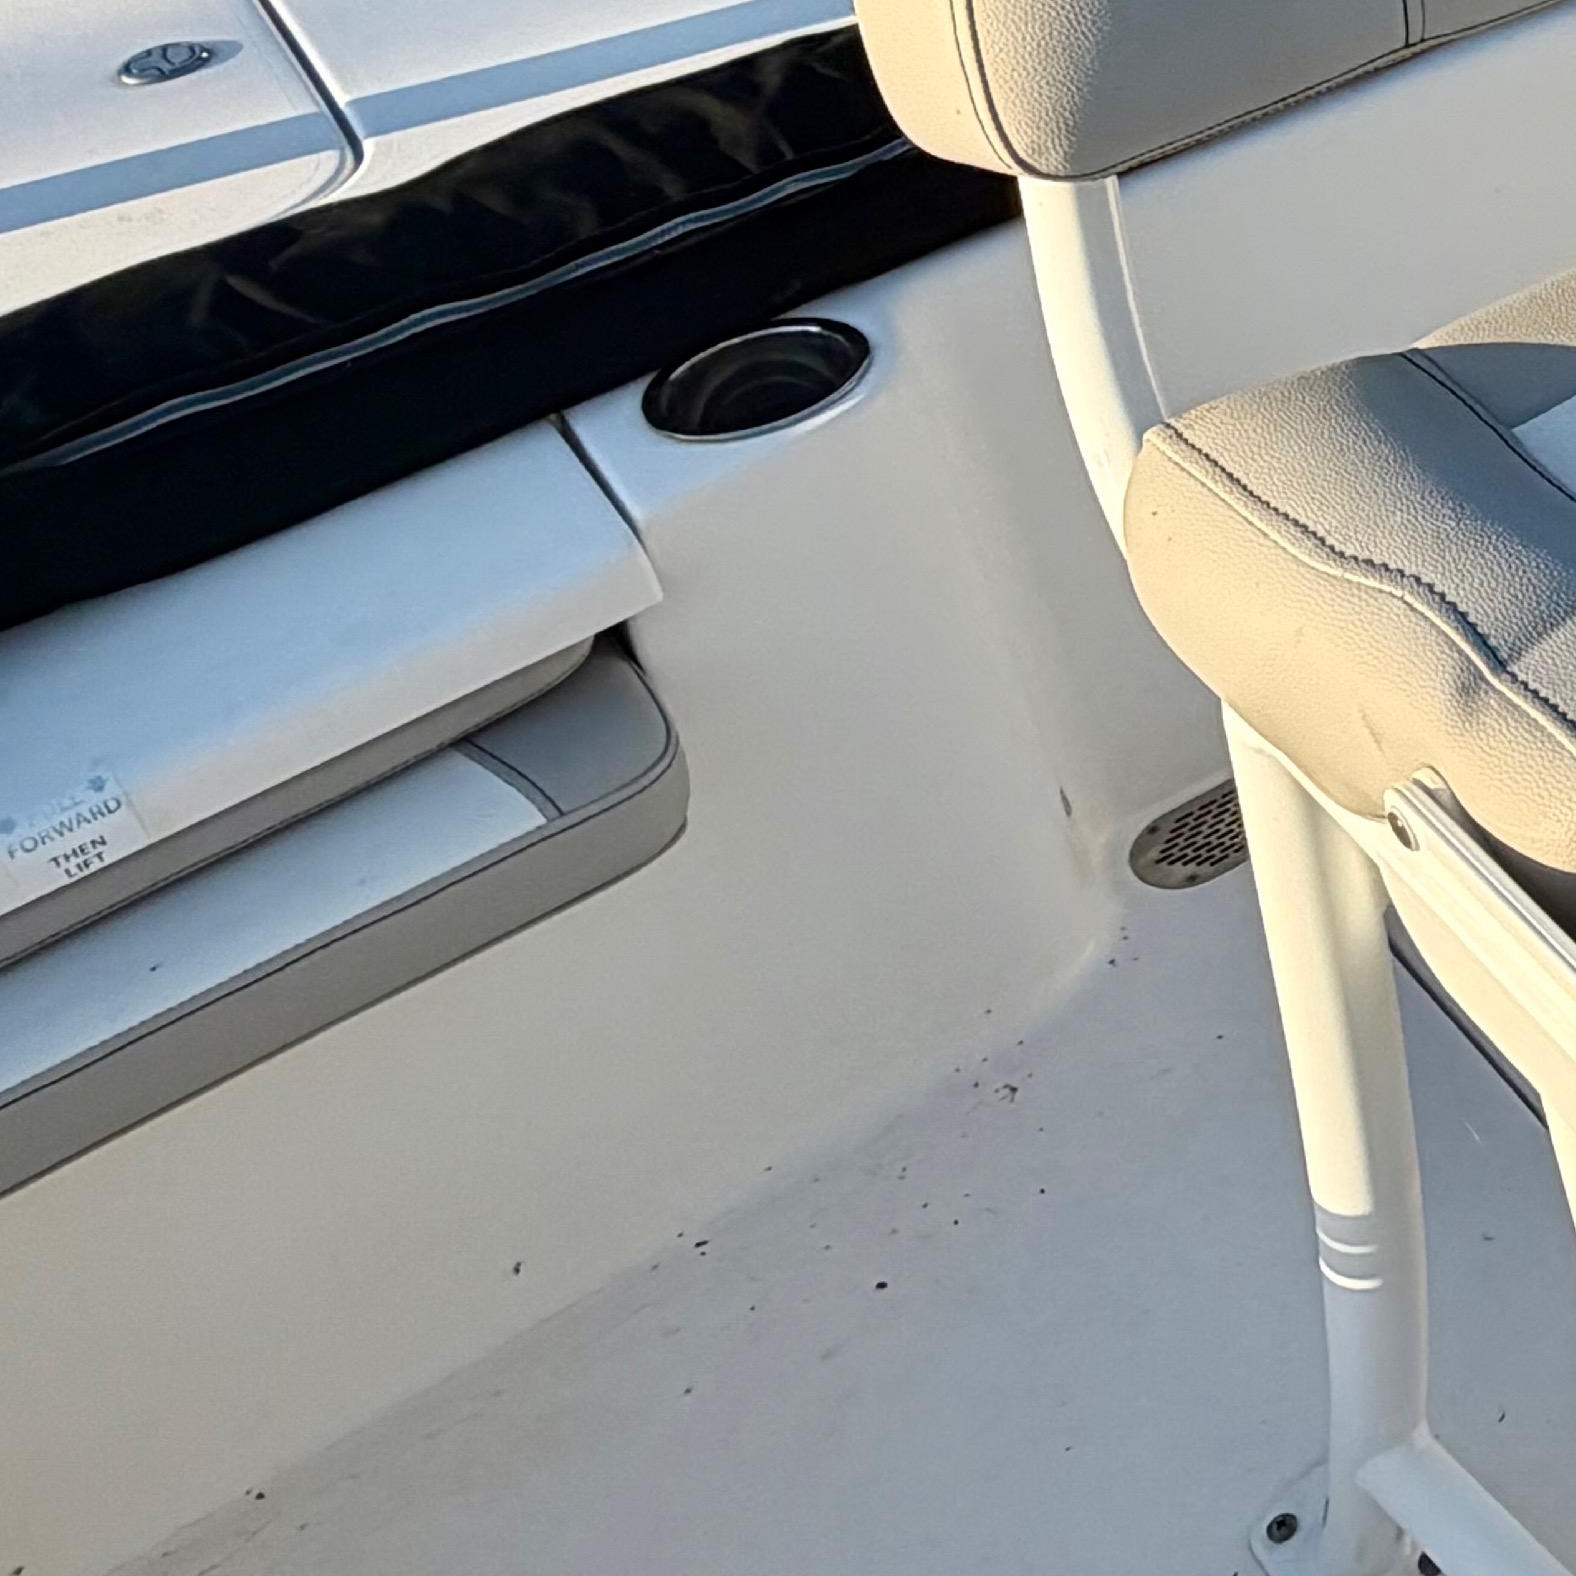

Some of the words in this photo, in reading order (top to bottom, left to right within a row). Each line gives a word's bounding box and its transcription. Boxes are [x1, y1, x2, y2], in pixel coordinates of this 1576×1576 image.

[7, 797, 122, 860] FORWARD
[49, 835, 108, 869] THEN
[64, 851, 106, 878] LIFT
